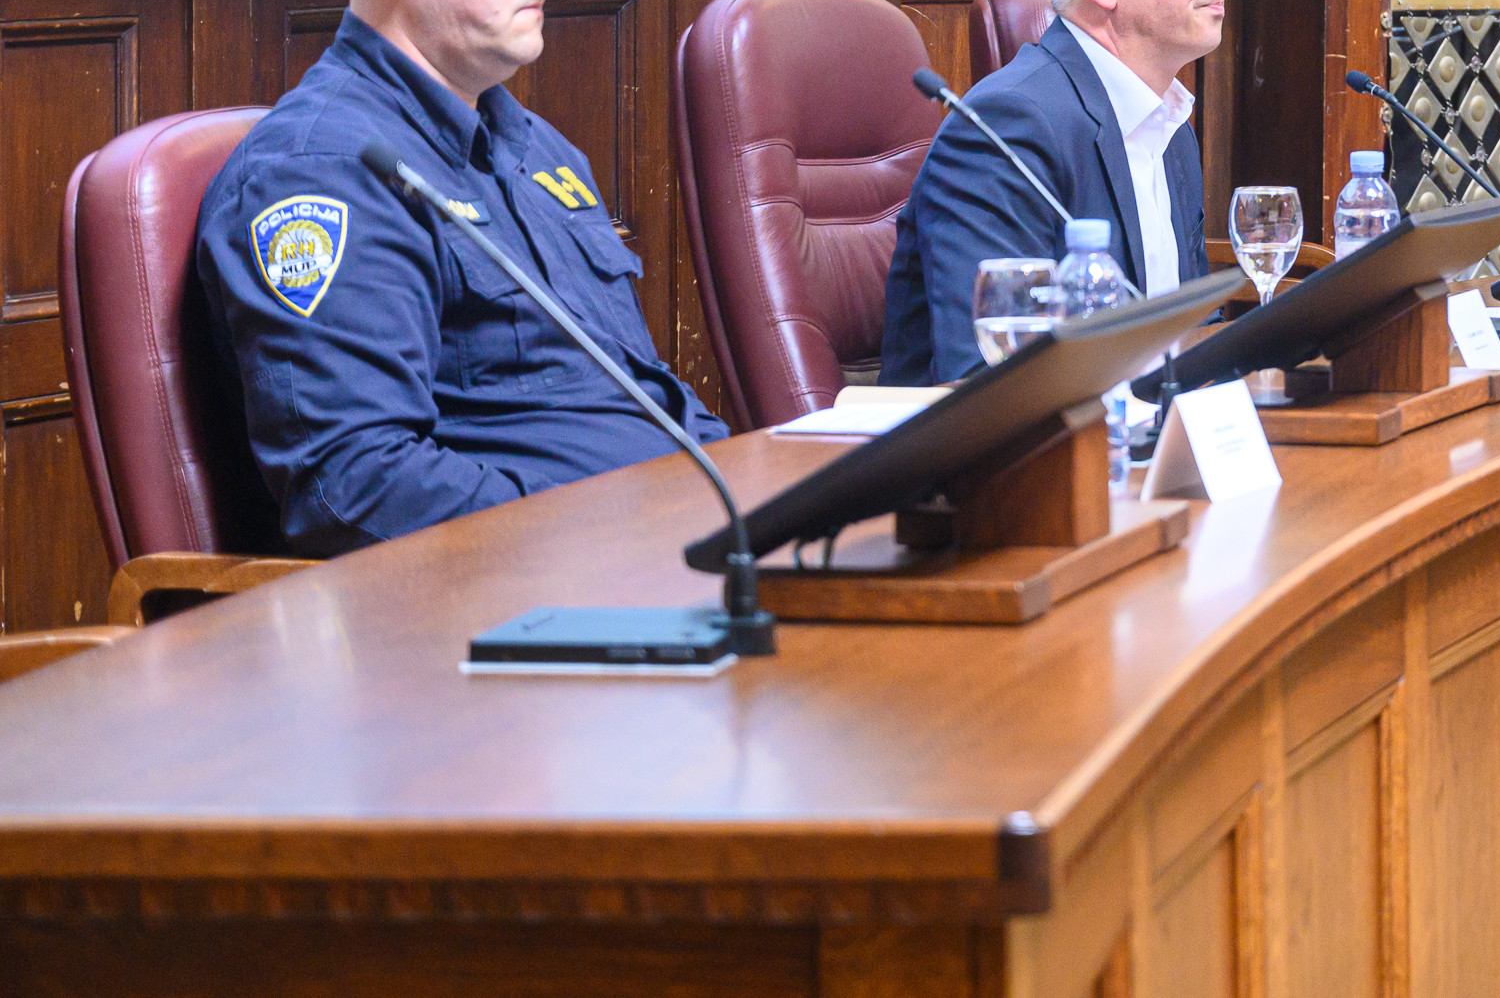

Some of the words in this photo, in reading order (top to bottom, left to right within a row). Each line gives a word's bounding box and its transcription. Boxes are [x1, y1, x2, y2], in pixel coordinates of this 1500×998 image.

[258, 203, 340, 236] POLICIJA
[281, 240, 315, 260] RH
[281, 259, 317, 275] MUP
